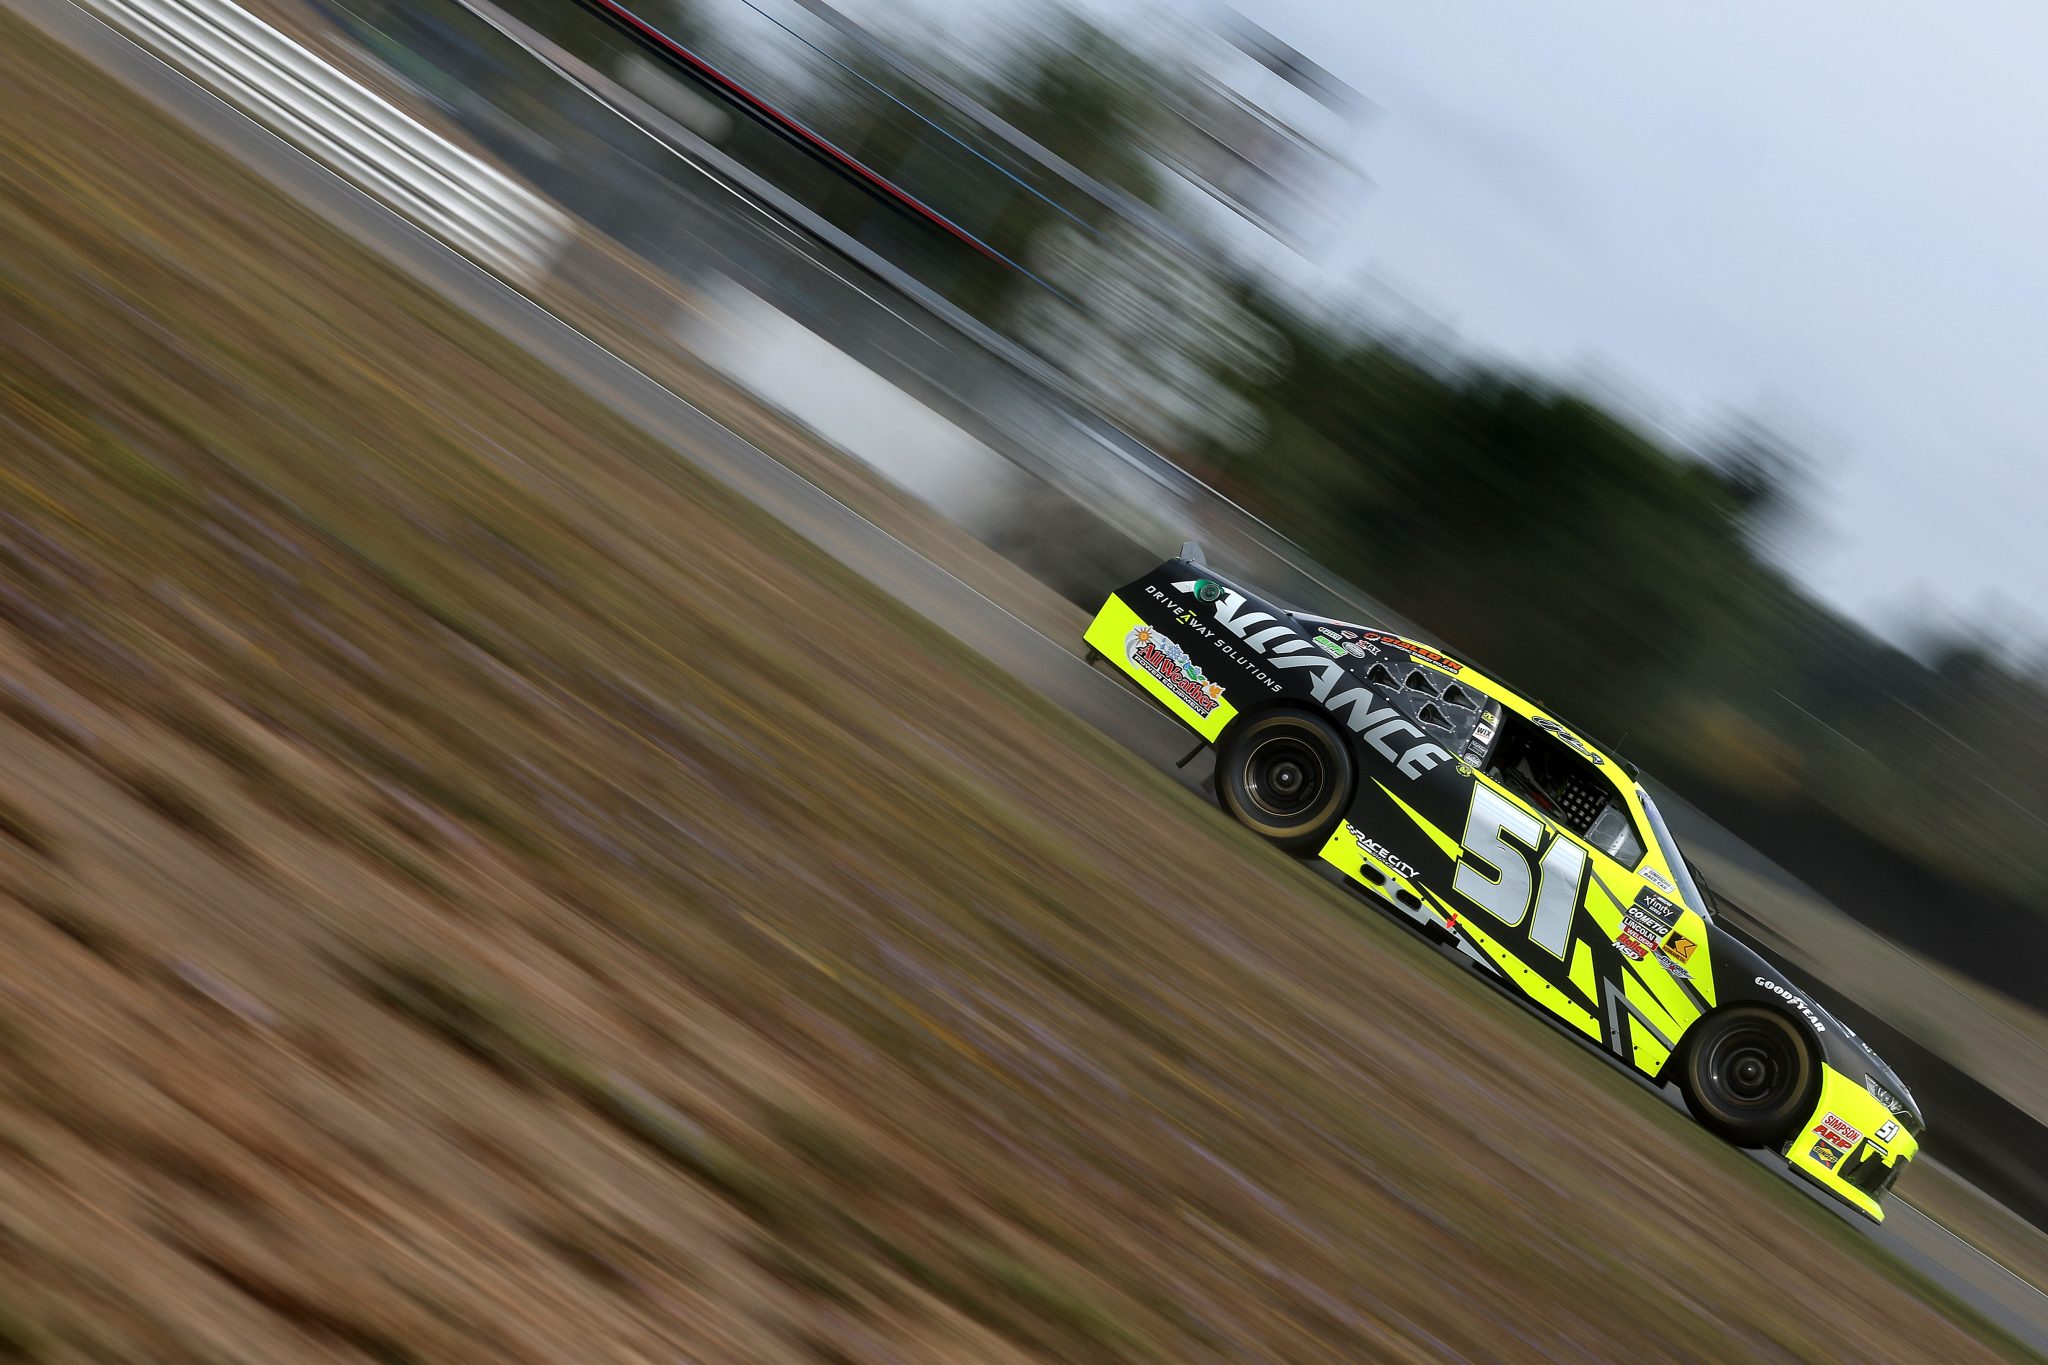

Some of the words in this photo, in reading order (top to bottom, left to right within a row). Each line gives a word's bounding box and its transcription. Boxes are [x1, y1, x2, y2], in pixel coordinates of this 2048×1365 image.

[1145, 585, 1216, 638] DRIVEAWAY
[1214, 639, 1283, 693] SOLUTIONS
[1134, 655, 1163, 680] POWER
[1162, 677, 1207, 716] EQUIPMENT
[1170, 579, 1453, 781] ALLIANCE
[1476, 726, 1492, 738] WIX
[1452, 780, 1590, 962] 51
[1623, 917, 1655, 942] LINCOLN
[1626, 927, 1655, 949] WELDERS
[1612, 941, 1641, 961] MSD
[1754, 976, 1826, 1033] GOODYEAR
[1812, 1125, 1853, 1149] ARP
[1824, 1115, 1861, 1142] SIMPSON
[1875, 1120, 1900, 1144] 51
